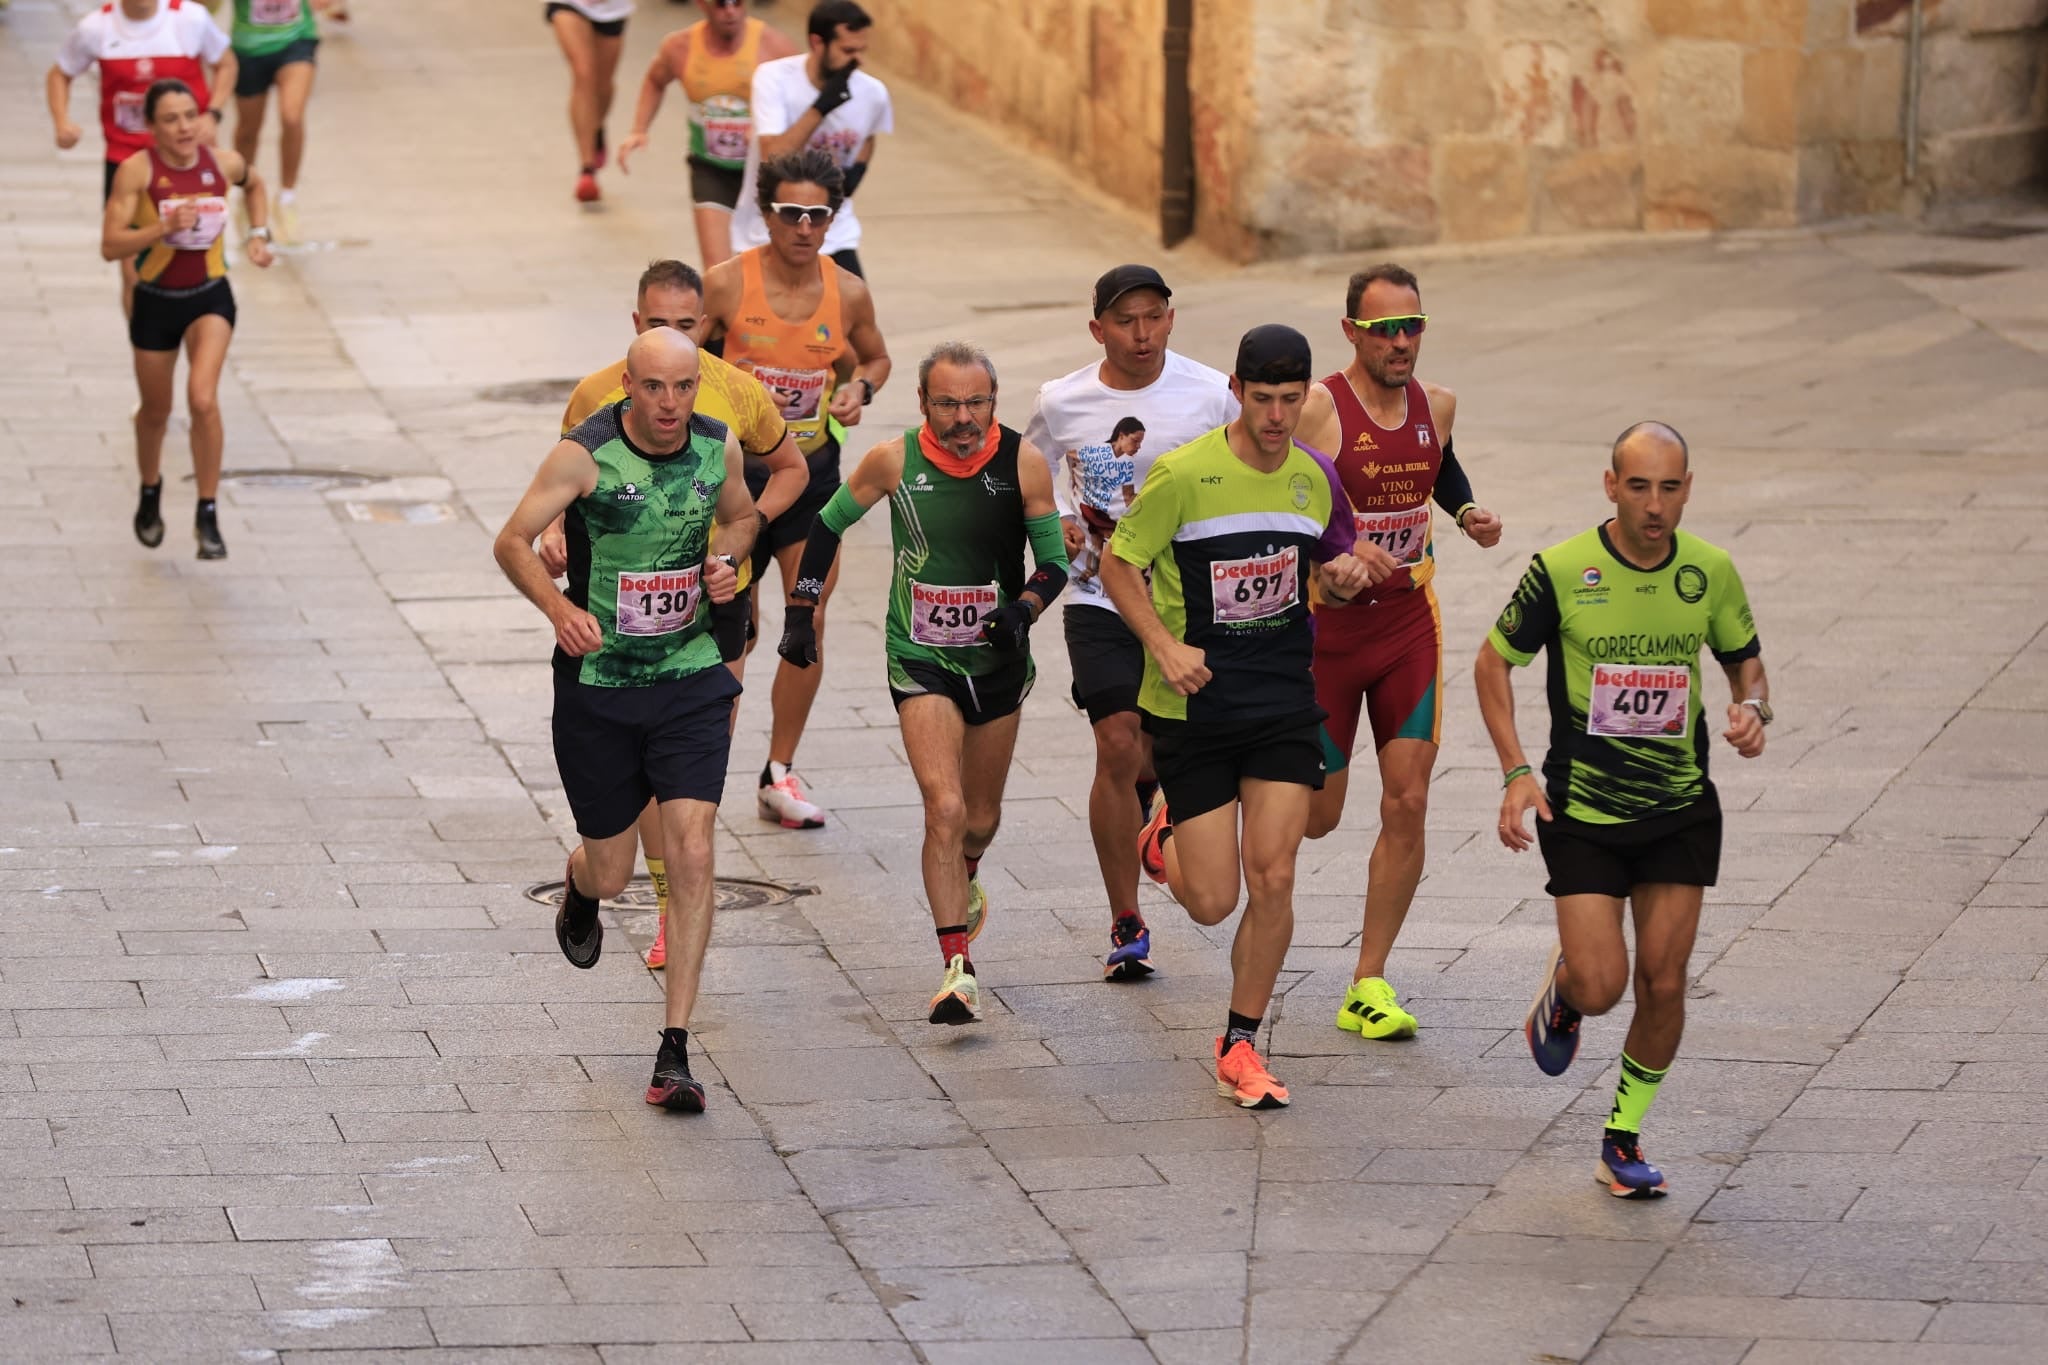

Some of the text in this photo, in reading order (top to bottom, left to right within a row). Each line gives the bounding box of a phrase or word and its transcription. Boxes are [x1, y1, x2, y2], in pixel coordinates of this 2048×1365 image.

[1382, 462, 1430, 474] CAJA RURAL
[1381, 480, 1414, 492] VINO
[1367, 492, 1423, 506] DE TORO
[1353, 511, 1429, 531] bedunia
[1368, 528, 1412, 552] 719
[1213, 554, 1296, 581] bedunia
[913, 585, 995, 605] bedunia
[1234, 572, 1283, 603] 697
[640, 590, 688, 615] 130
[929, 605, 978, 627] 430
[1587, 633, 1703, 658] CORRECAMINOS
[1595, 668, 1687, 688] bedunia
[1613, 689, 1669, 715] 407
